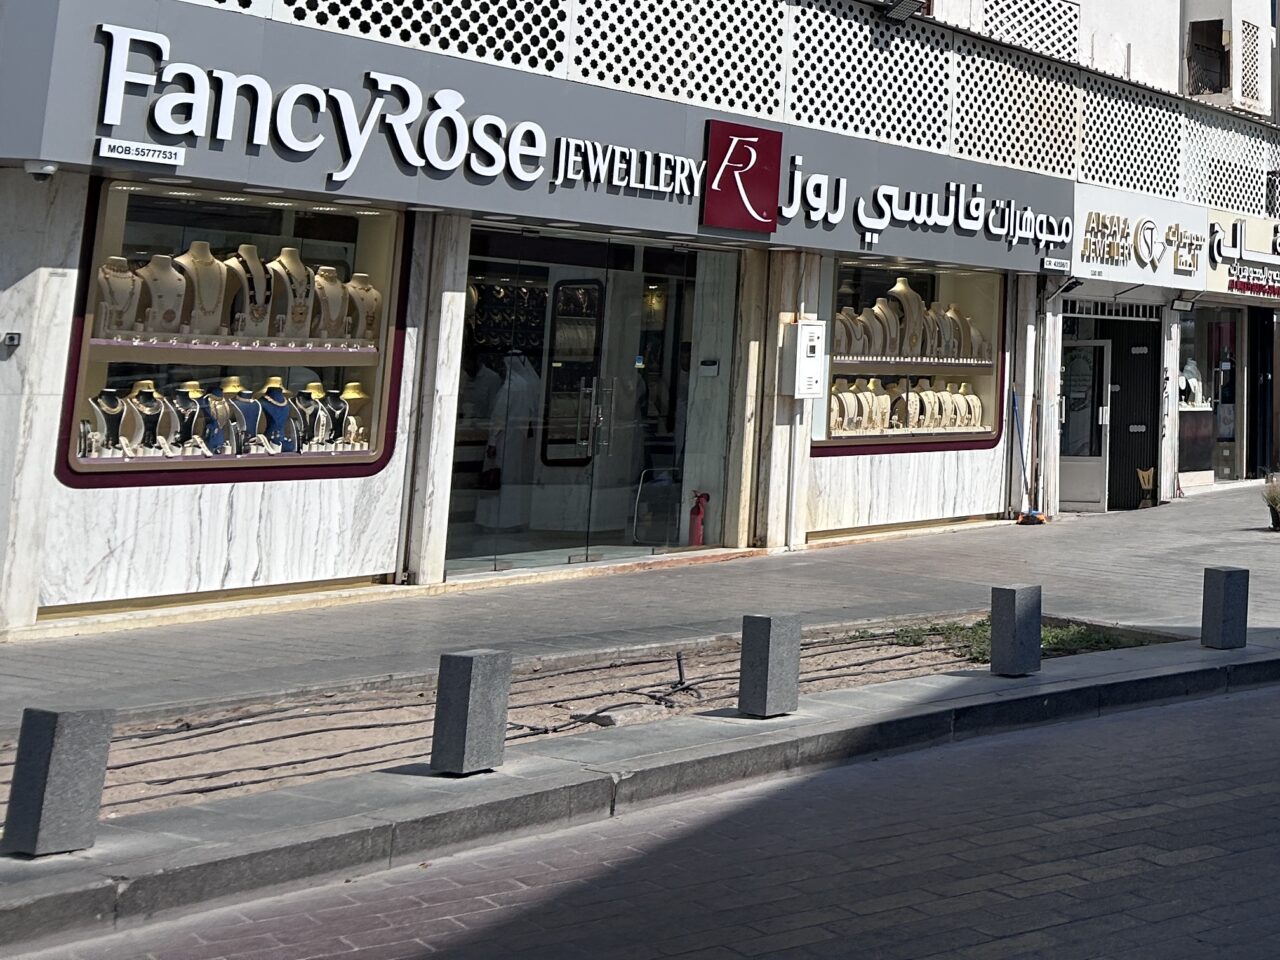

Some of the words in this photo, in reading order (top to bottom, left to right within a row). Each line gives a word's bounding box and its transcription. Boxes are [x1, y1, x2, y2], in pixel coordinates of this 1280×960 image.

[107, 144, 178, 160] MOB:55777531
[555, 137, 707, 197] JEWELLERY
[777, 156, 847, 224] روز
[857, 182, 986, 244] فانسي
[988, 199, 1073, 248] مجوهرات
